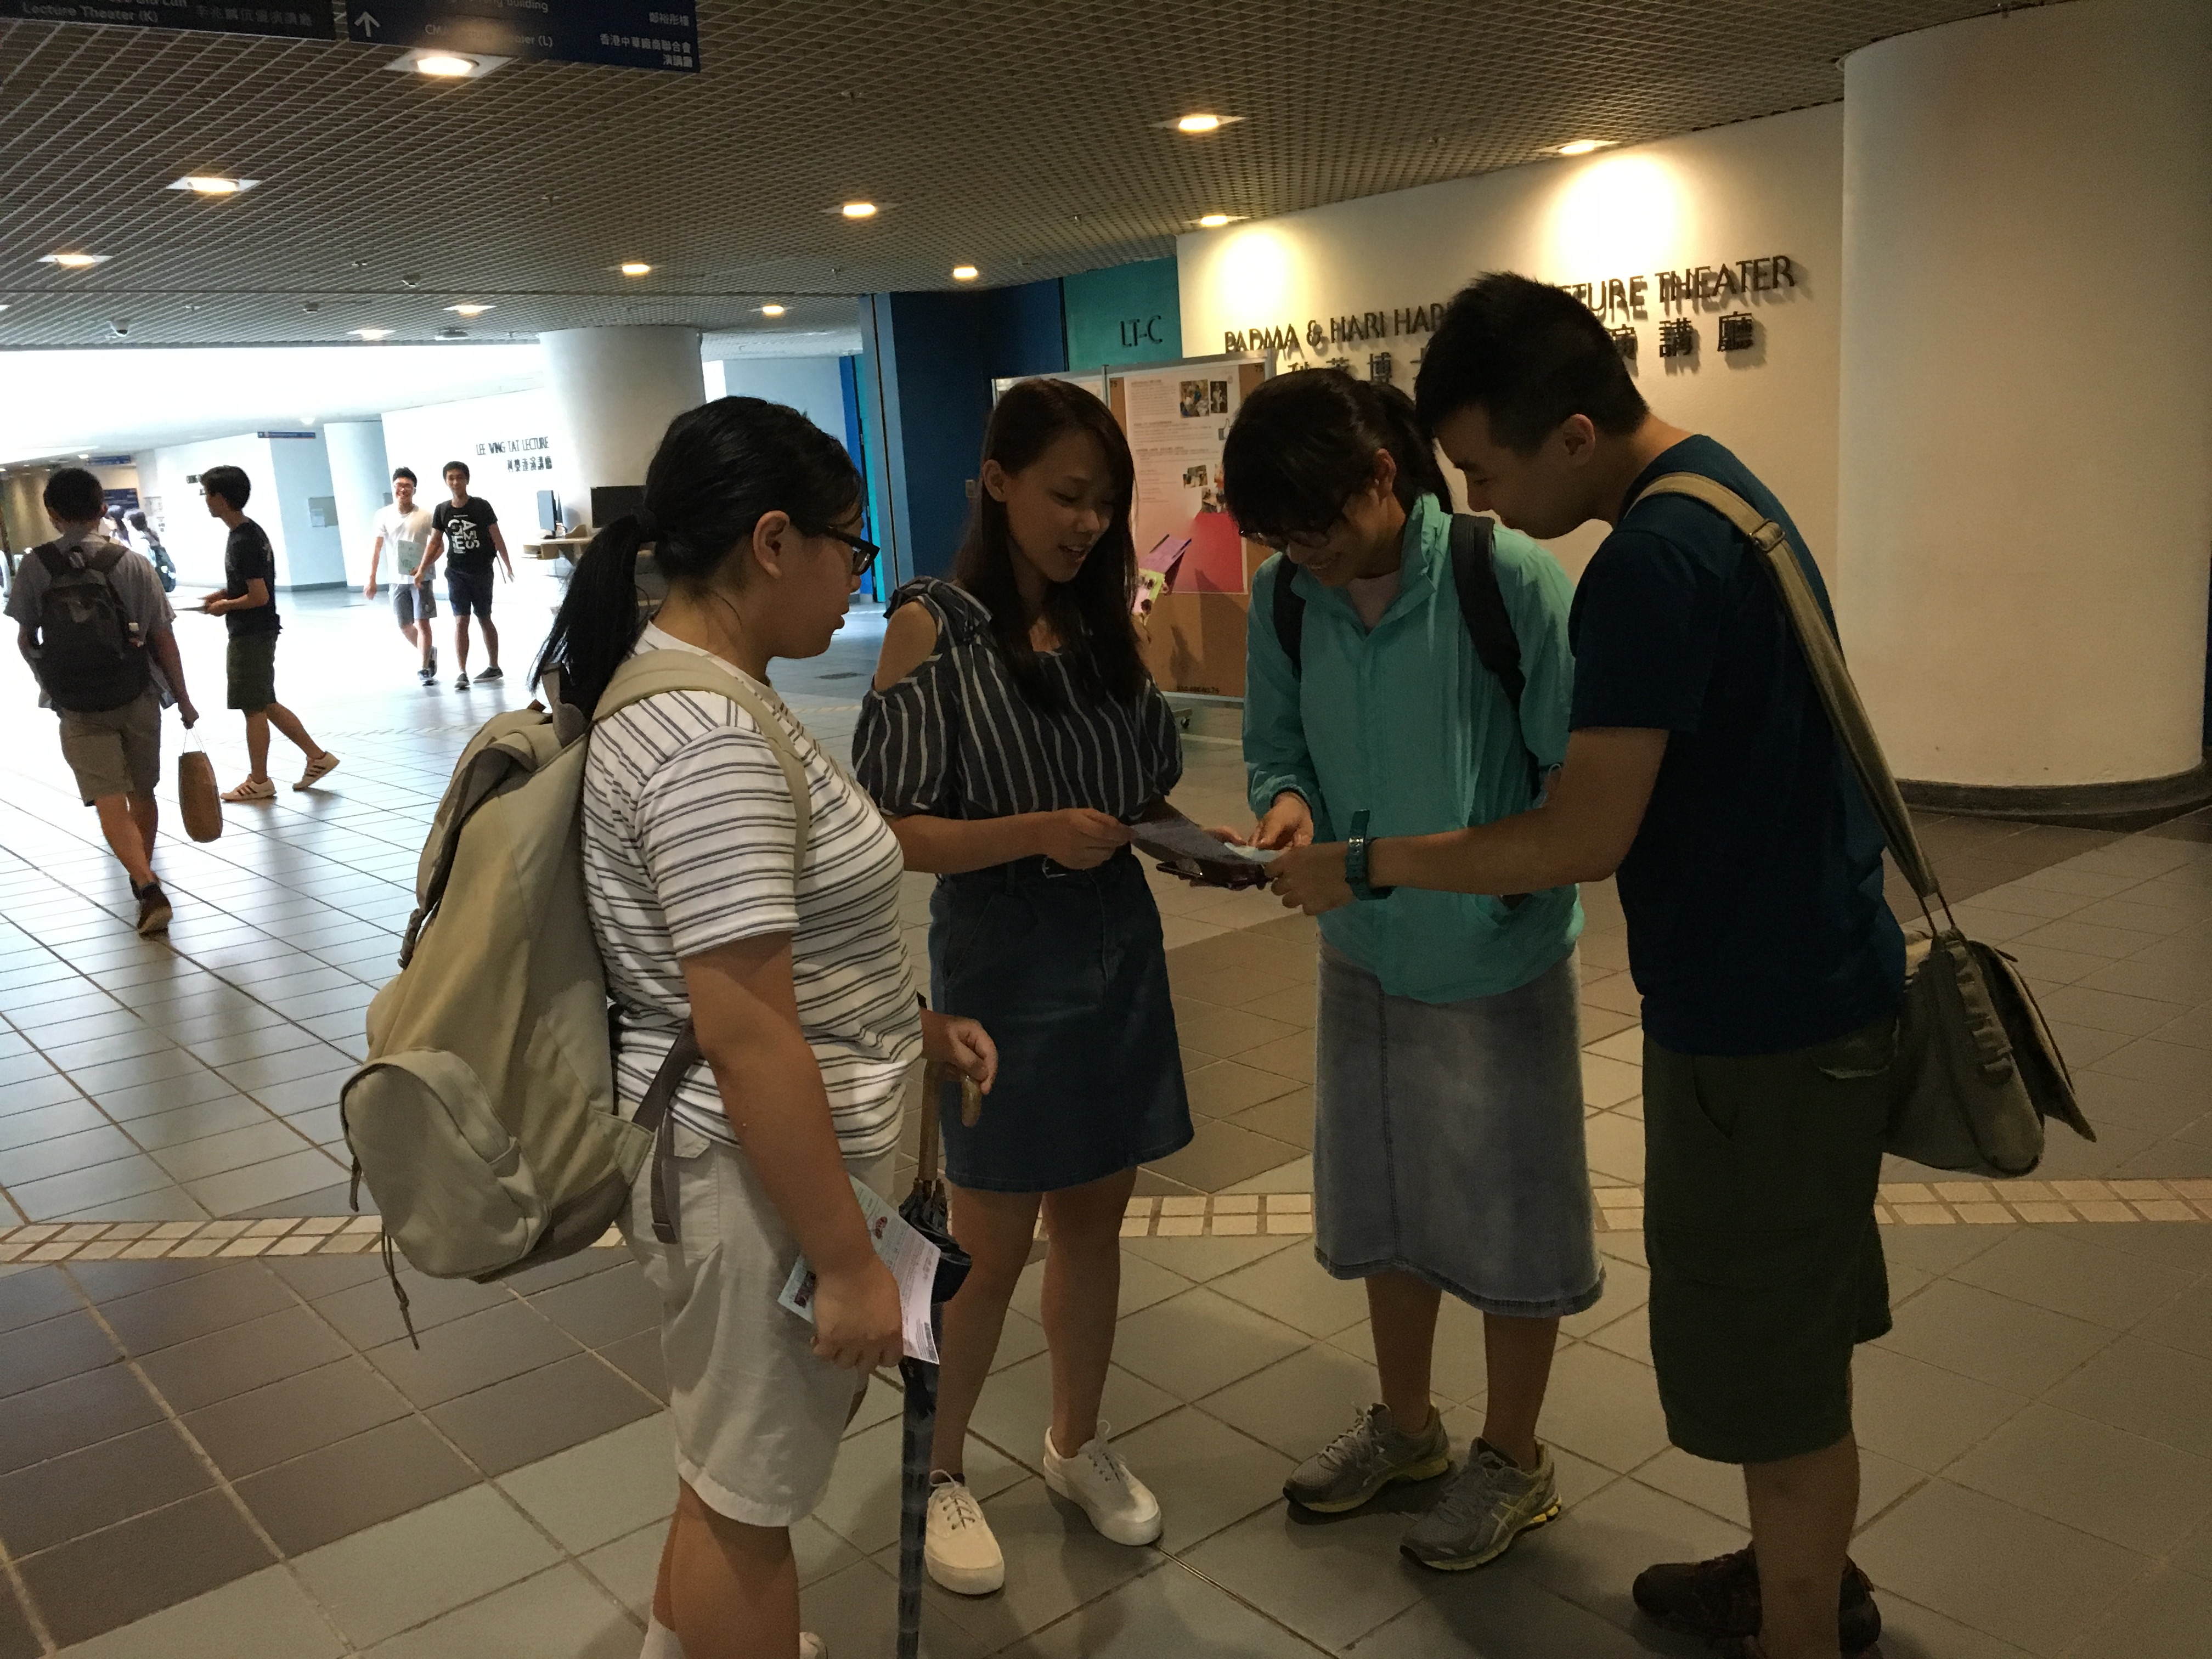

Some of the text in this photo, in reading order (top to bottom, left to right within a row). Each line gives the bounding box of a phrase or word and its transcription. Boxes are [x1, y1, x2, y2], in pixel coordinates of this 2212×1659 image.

[22, 2, 77, 16] Lecture
[79, 5, 134, 21] Theater
[538, 35, 553, 48] (L)
[1224, 323, 1304, 354] PADMA
[1306, 320, 1322, 347] &
[1330, 311, 1385, 343] HARI
[1654, 255, 1796, 303] THEATER
[1120, 315, 1163, 347] LT-C
[476, 443, 487, 455] LEE
[507, 439, 520, 452] TAT
[522, 436, 549, 451] LECTURE
